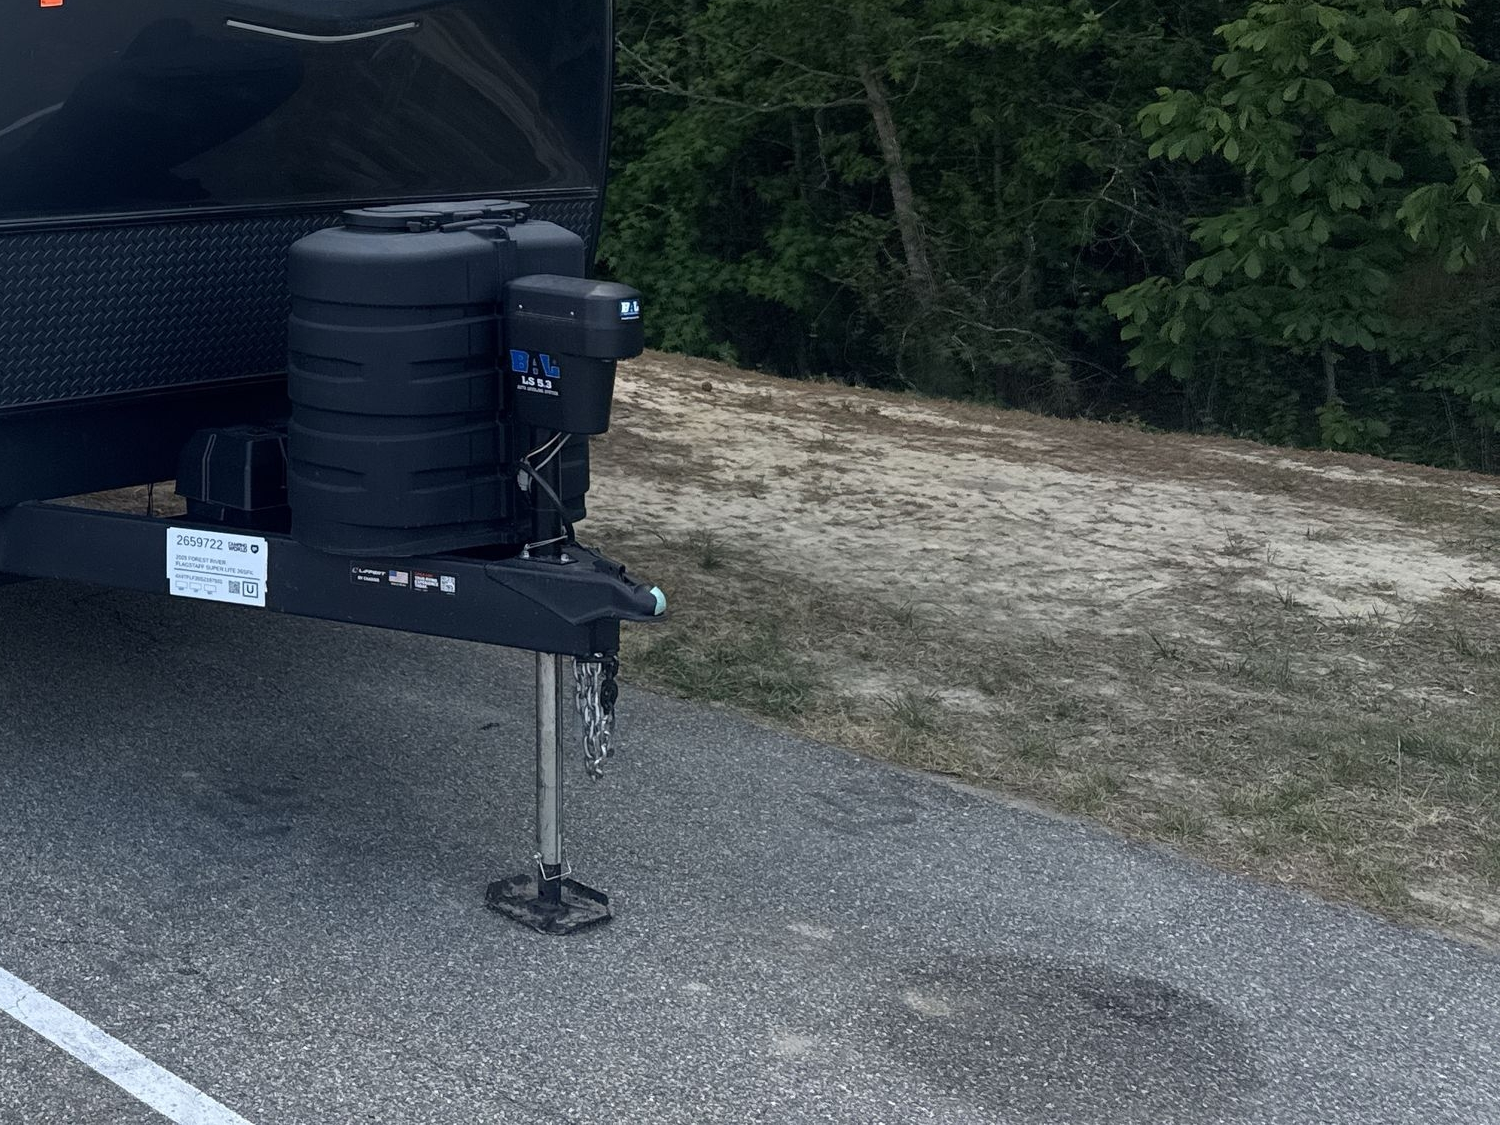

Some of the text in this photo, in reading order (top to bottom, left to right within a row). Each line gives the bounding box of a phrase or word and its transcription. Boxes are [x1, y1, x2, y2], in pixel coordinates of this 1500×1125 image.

[521, 375, 552, 389] LS 5.3
[176, 534, 223, 550] 2659722
